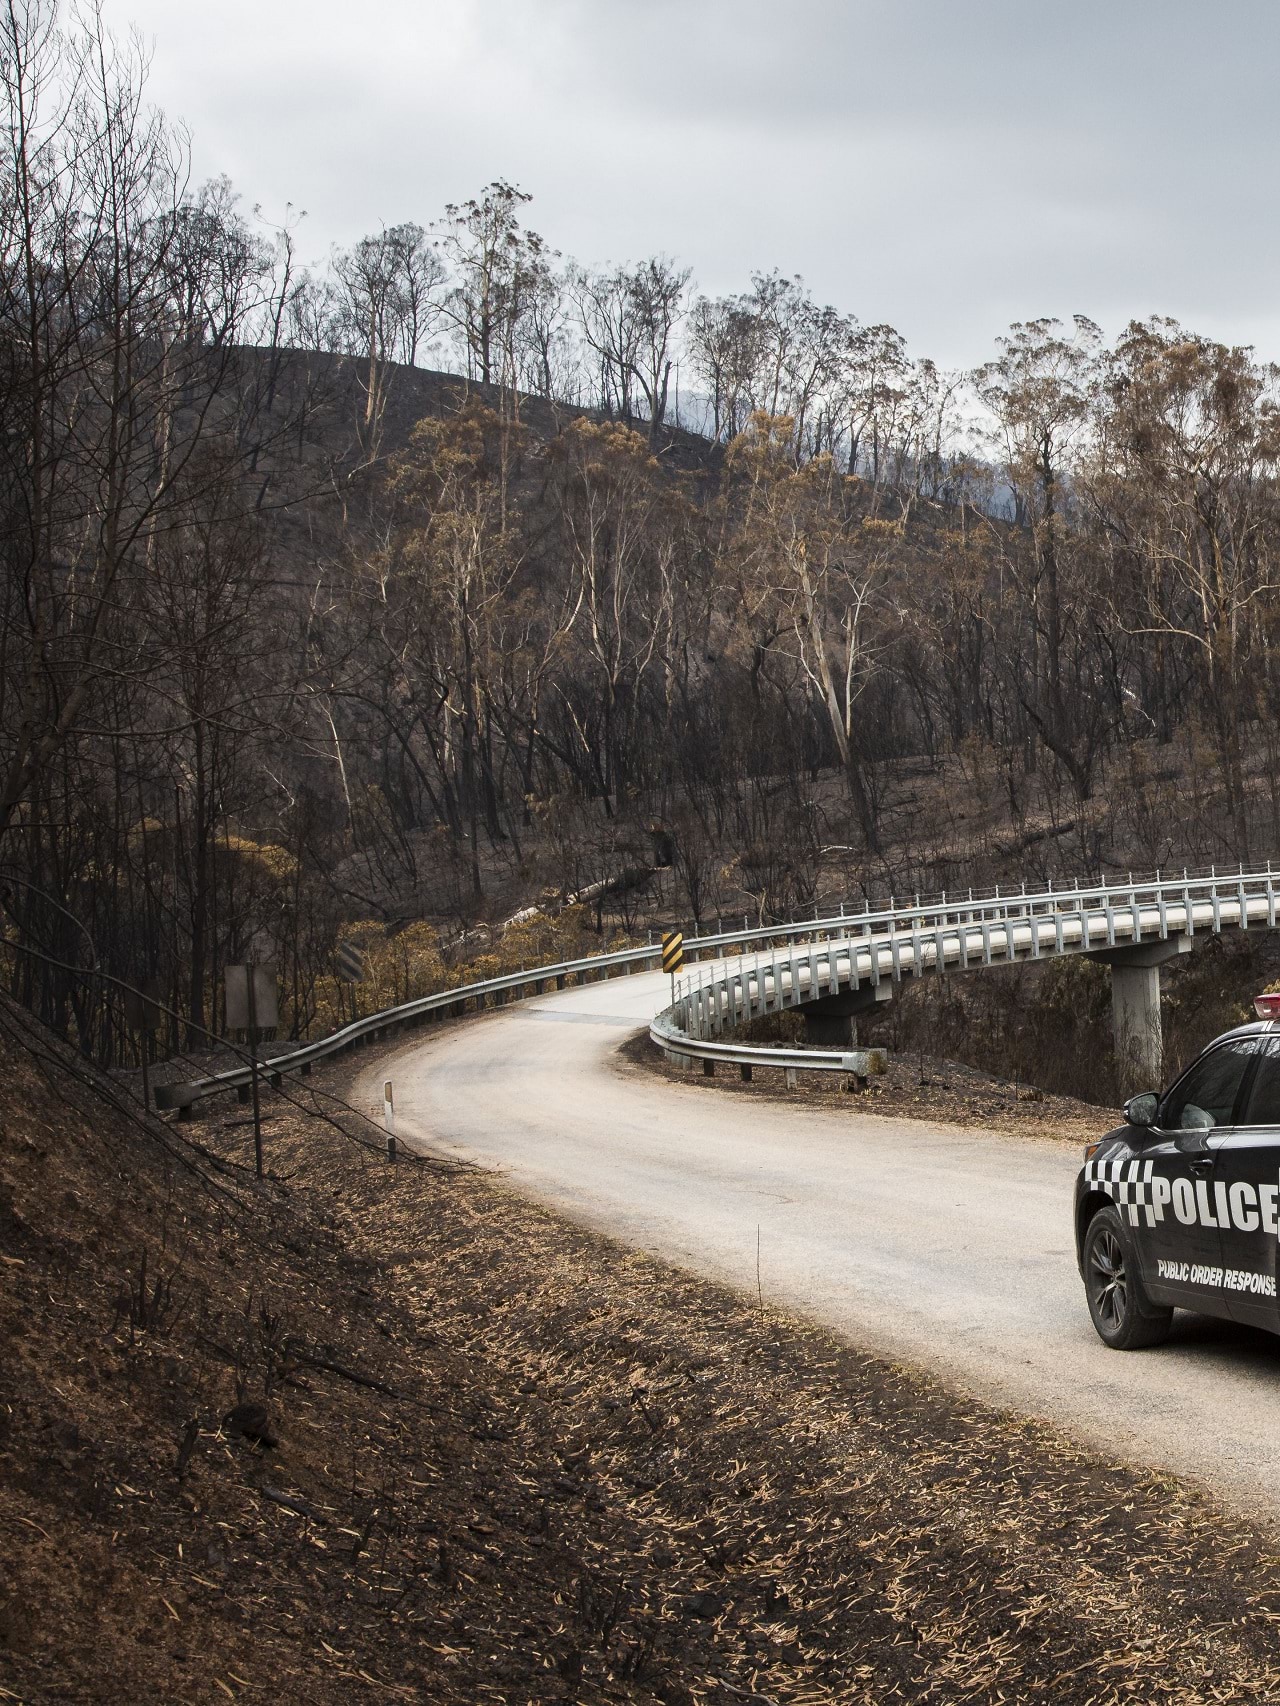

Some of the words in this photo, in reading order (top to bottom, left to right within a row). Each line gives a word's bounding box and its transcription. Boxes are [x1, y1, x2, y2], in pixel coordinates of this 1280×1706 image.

[1152, 1176, 1278, 1234] POLICE
[1157, 1259, 1189, 1282] PUBLIC
[1190, 1264, 1223, 1287] ORDER
[1223, 1269, 1277, 1297] RESPONSE
